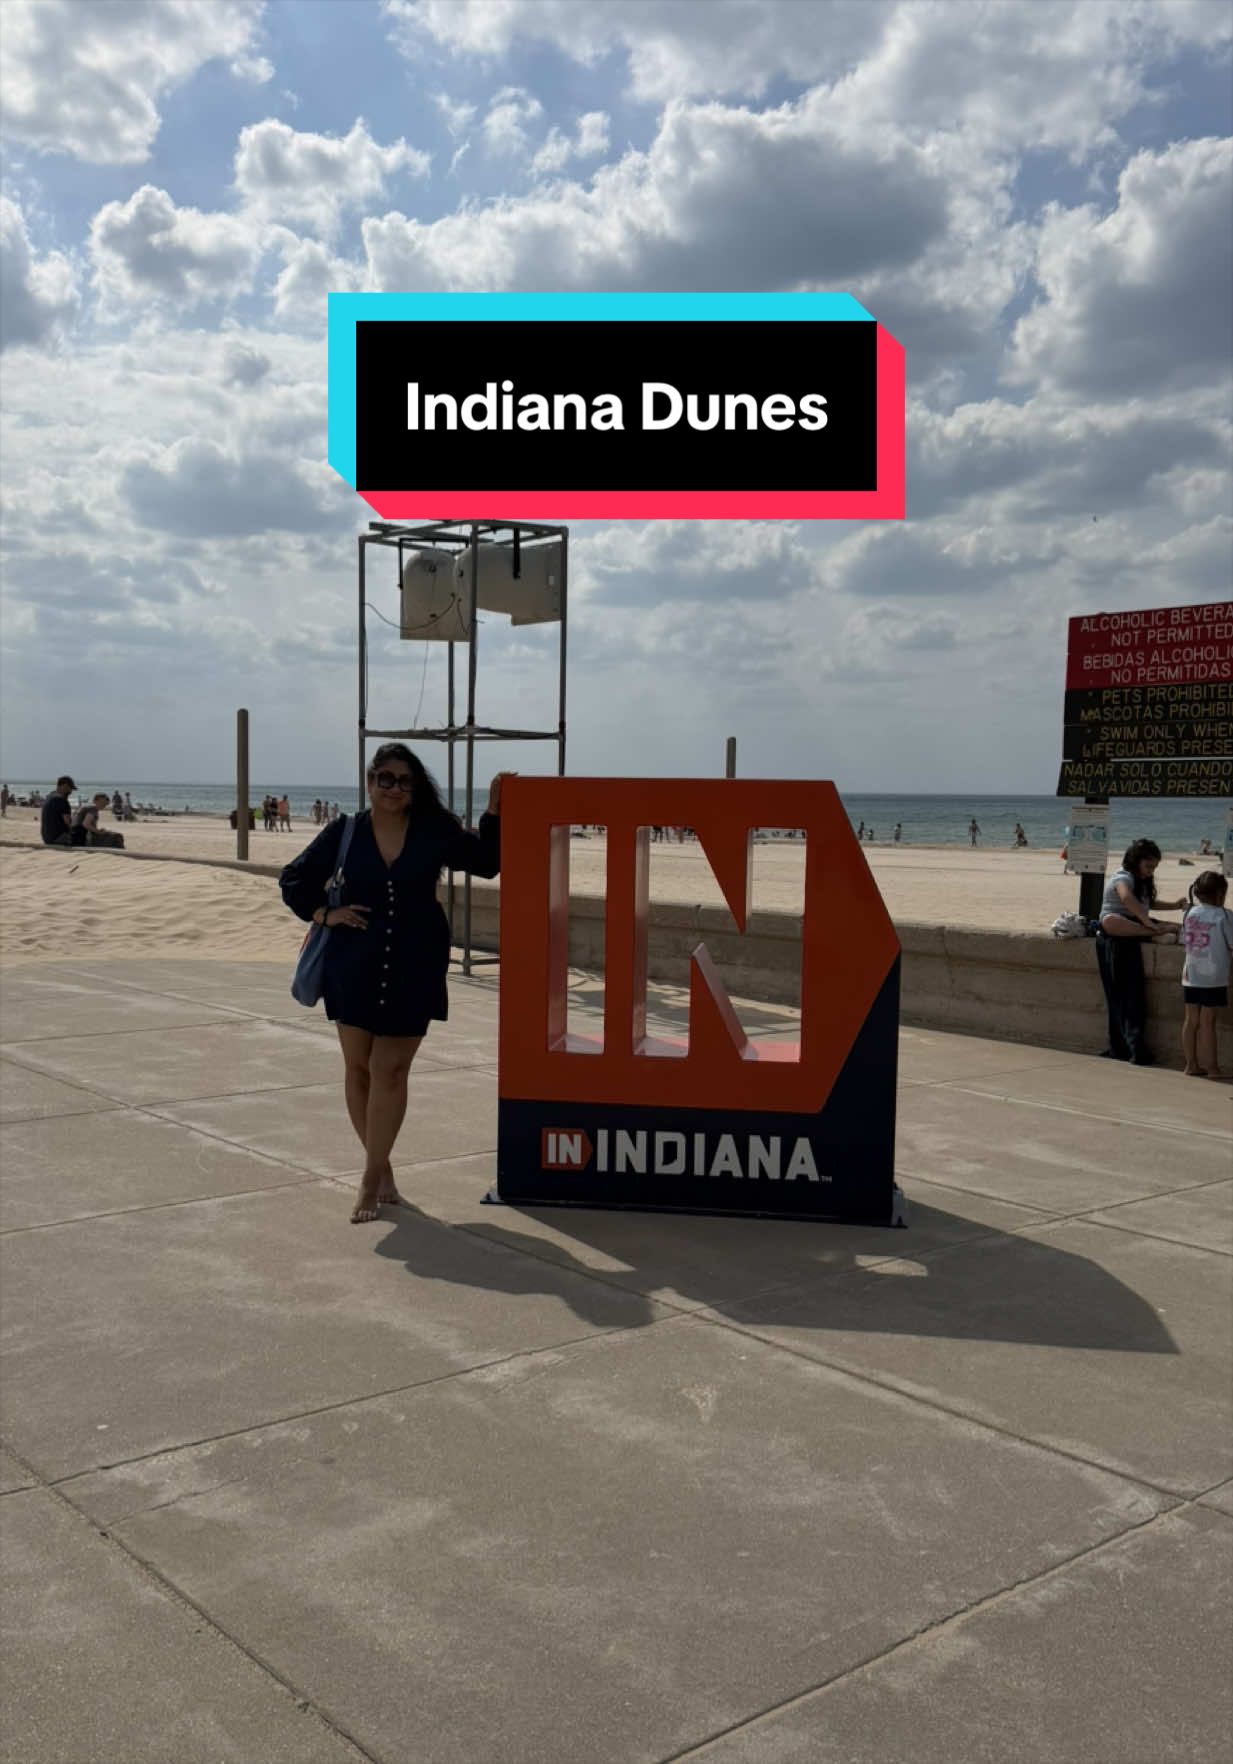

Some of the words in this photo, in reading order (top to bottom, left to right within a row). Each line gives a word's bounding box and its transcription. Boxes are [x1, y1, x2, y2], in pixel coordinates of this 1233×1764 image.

[1080, 611, 1167, 632] ALCOHOLIC
[1111, 631, 1144, 647] NOT
[1147, 623, 1233, 643] PERMITTED
[1083, 651, 1145, 670] BEBIDAS
[1150, 646, 1233, 665] ALCOHOLI
[1111, 670, 1132, 684] NO
[1137, 662, 1231, 682] PERMITIDAS
[1102, 688, 1141, 704] PETS
[1080, 704, 1164, 721] MASCOTAS
[1170, 702, 1233, 720] PROHIBI
[1100, 726, 1138, 740] SWIM
[1143, 723, 1186, 738] ONLY
[1082, 740, 1176, 758] LIFEGUARDS
[1064, 763, 1115, 777] NADAR
[1119, 762, 1162, 777] SOLO
[1167, 761, 1232, 776] CUANDO
[547, 823, 808, 1063] IN
[547, 1133, 582, 1164] IN
[596, 1128, 821, 1182] INDIANA
